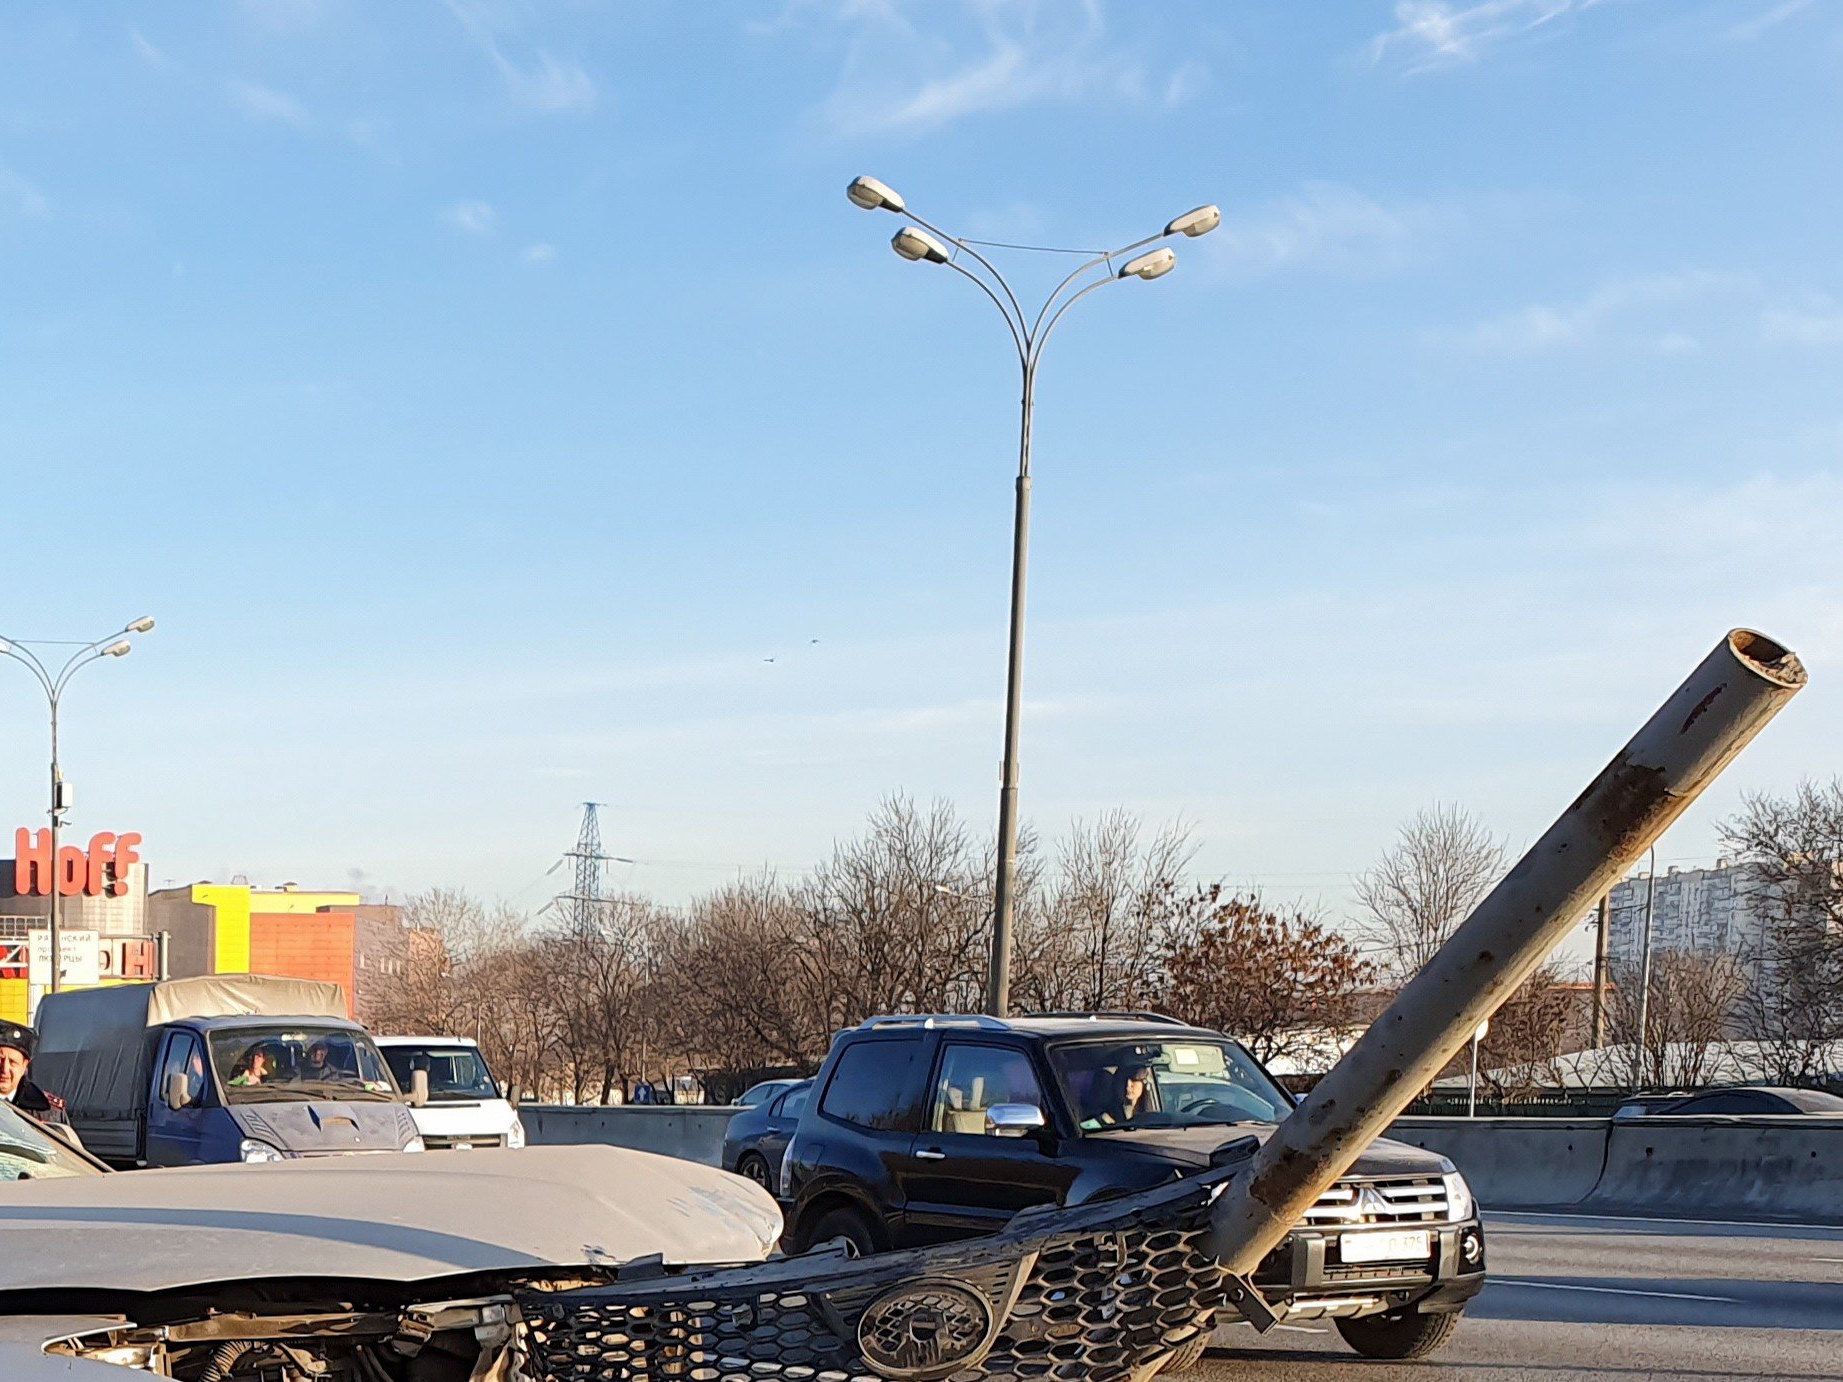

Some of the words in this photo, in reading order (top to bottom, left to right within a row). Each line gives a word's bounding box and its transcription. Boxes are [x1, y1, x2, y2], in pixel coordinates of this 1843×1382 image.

[15, 827, 142, 896] Hoff
[37, 934, 91, 942] РЯНСКИЙ
[38, 954, 83, 963] ЛЮРЦЫ
